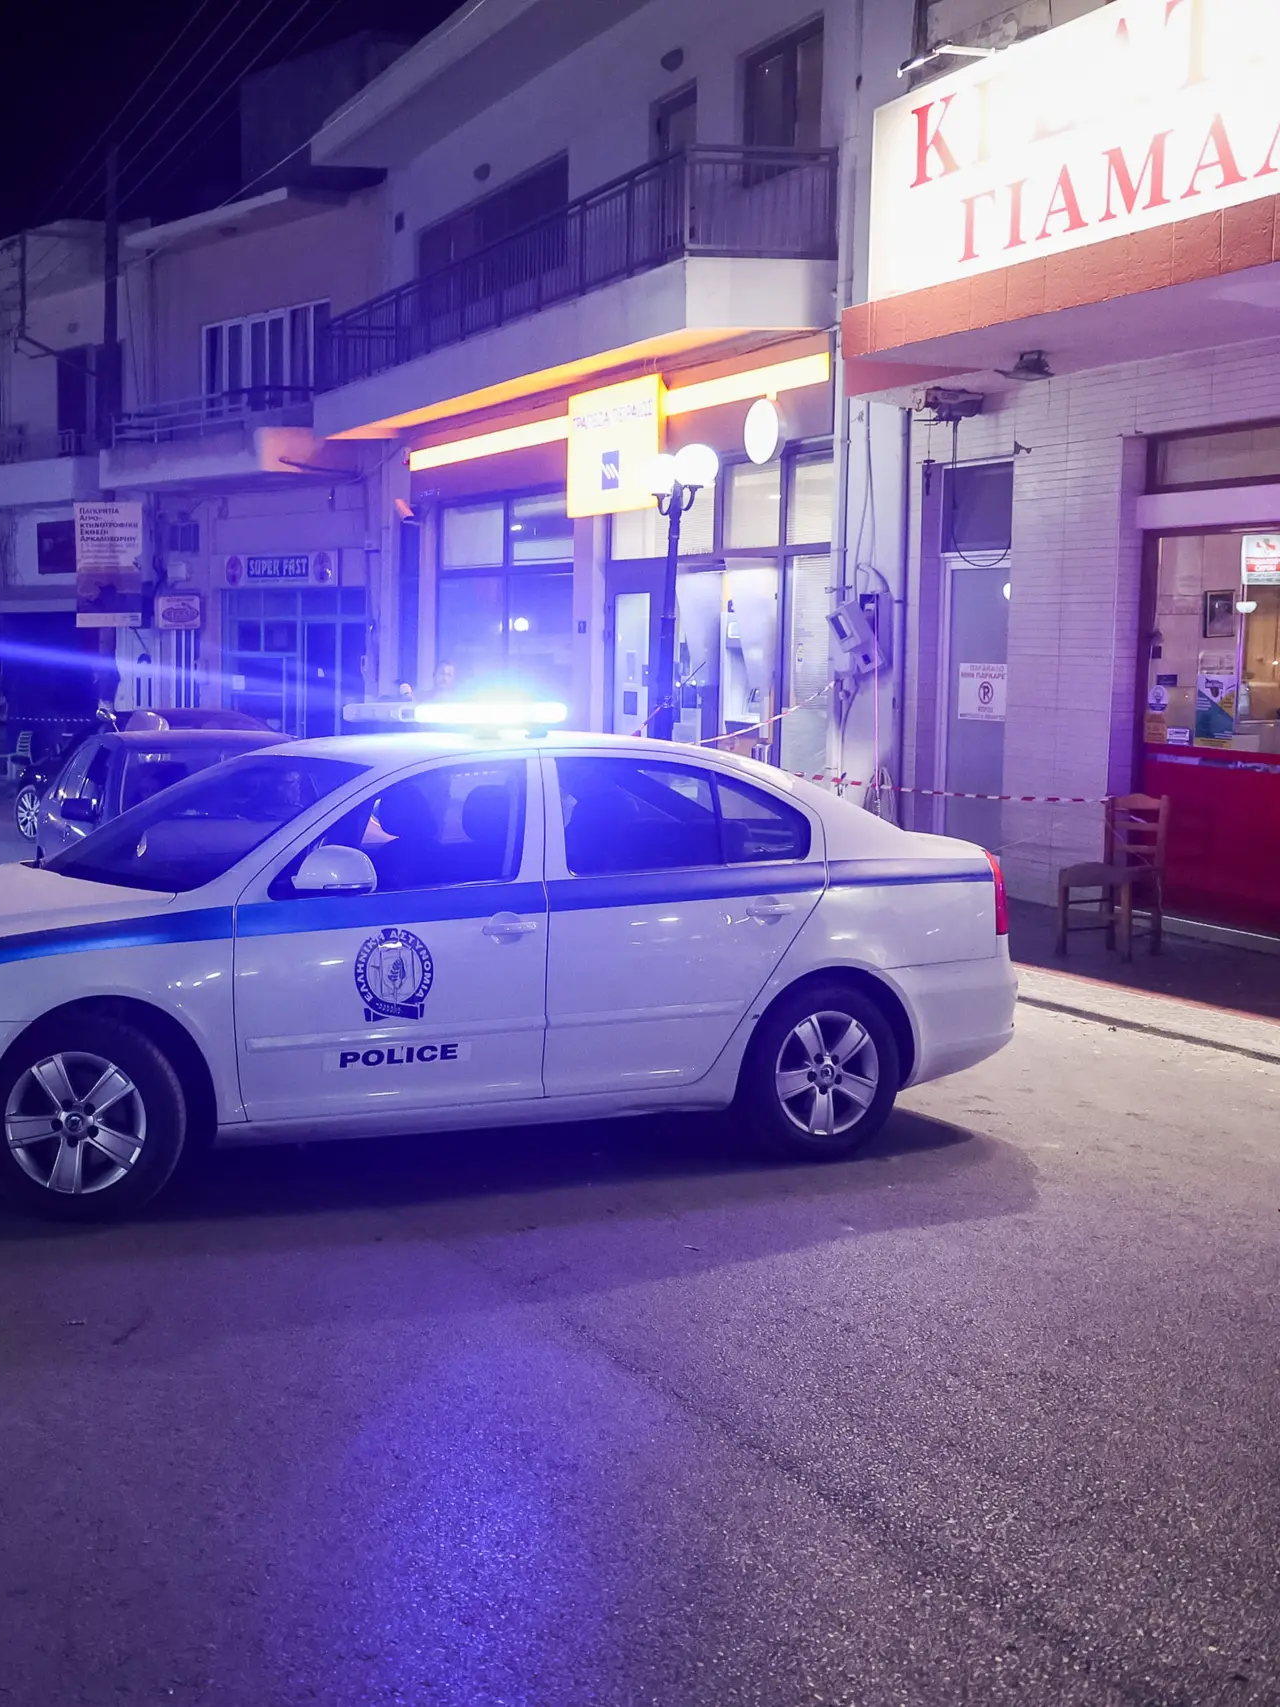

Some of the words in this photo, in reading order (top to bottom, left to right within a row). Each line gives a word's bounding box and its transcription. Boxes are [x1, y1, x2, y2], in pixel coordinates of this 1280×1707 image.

[249, 558, 280, 576] SUPER
[282, 557, 308, 576] FAST
[356, 931, 386, 1002] ΕΛΛΗΝΙΚΗ
[389, 930, 431, 998] ΑΣΤΥΝΟΜΙΑ
[339, 1043, 458, 1068] POLICE
